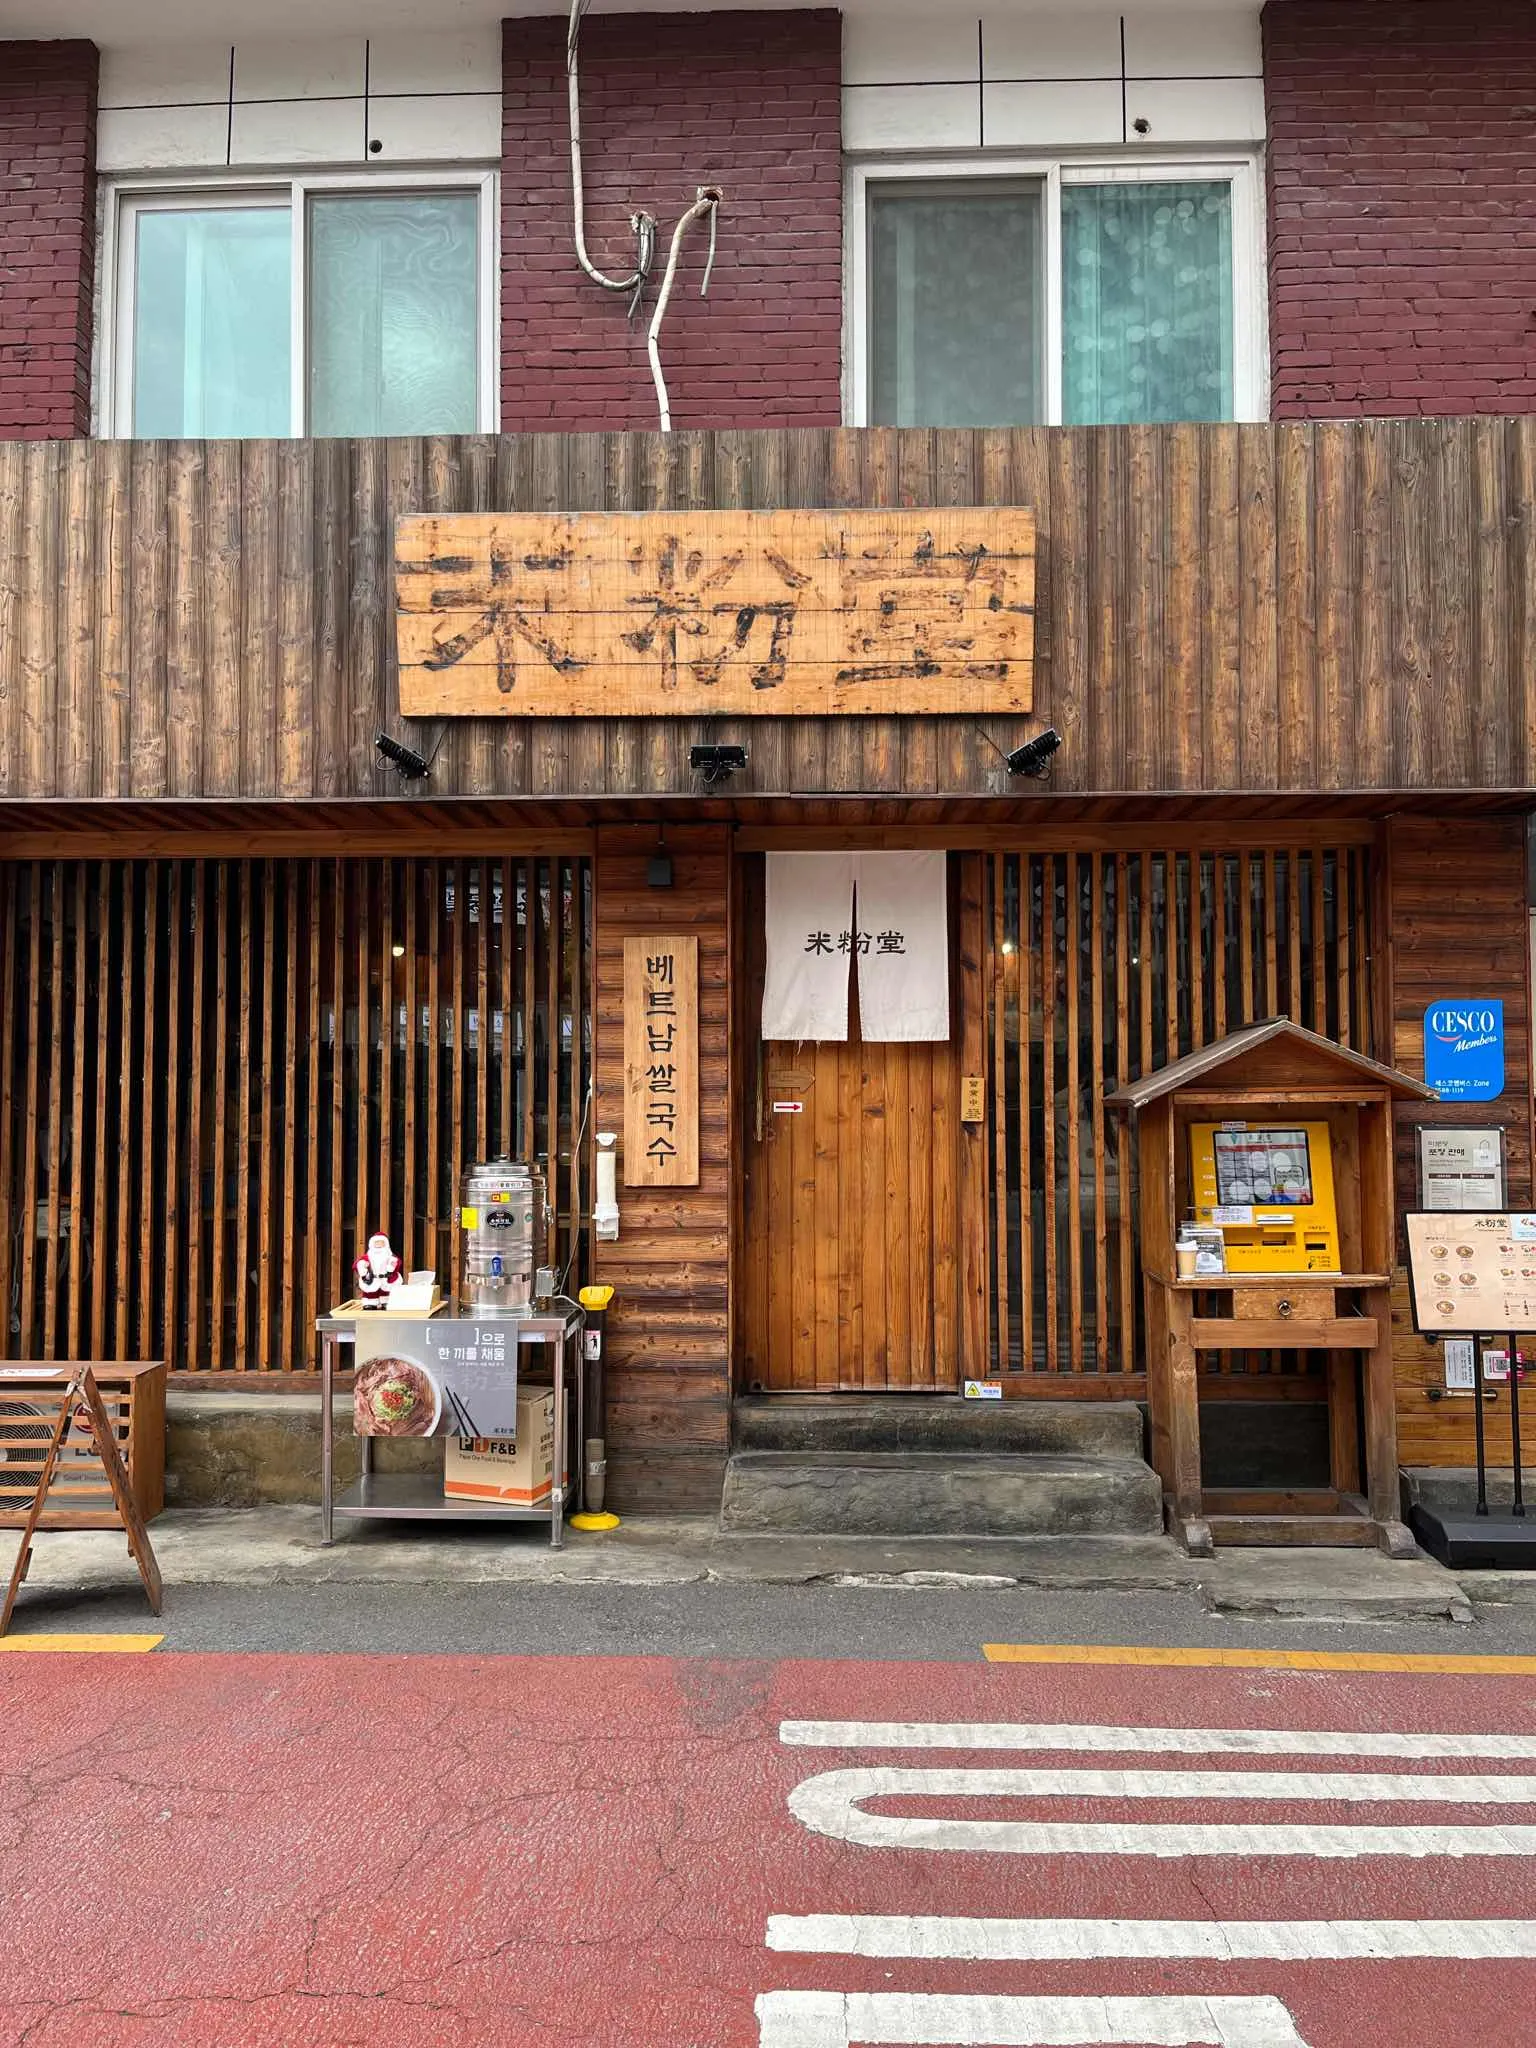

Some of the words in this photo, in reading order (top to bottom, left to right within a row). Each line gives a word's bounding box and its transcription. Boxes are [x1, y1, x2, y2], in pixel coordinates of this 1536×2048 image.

[421, 528, 1010, 694] 米粉堂
[804, 930, 906, 956] 米粉堂
[1432, 1010, 1495, 1033] CESCO
[1453, 1033, 1498, 1053] Members
[438, 1347, 450, 1360] 한
[454, 1347, 477, 1361] 끼를
[481, 1347, 505, 1361] 채움
[490, 1442, 516, 1456] F&B
